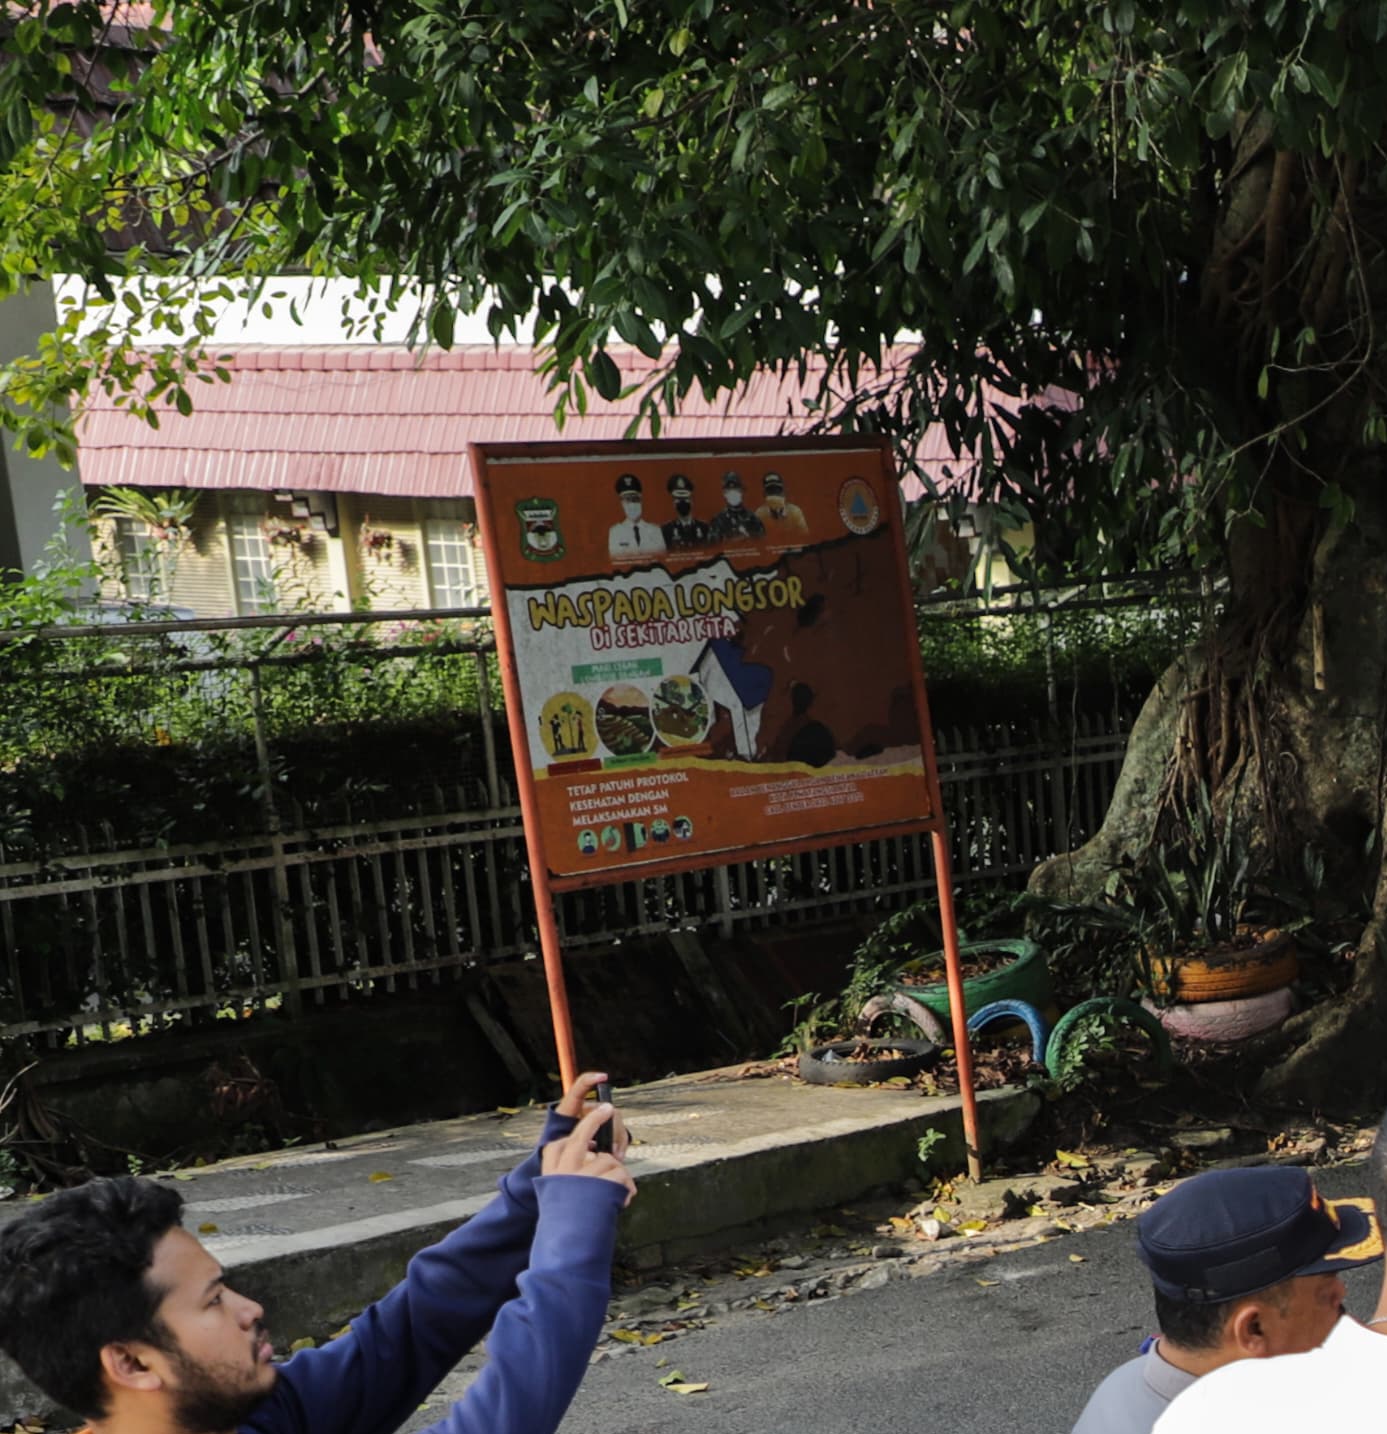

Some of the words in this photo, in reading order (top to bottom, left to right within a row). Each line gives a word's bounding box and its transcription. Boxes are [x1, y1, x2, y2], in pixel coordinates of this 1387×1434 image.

[528, 587, 674, 630] WASPADA
[675, 576, 806, 619] LONGSOR
[566, 783, 599, 796] TETAP
[600, 778, 635, 792] PATUHI
[636, 772, 689, 787] PROTOKOL
[569, 795, 627, 812] KESEHATAN
[628, 788, 670, 804] DENGAN
[572, 806, 652, 826] MELAKSANAKAN
